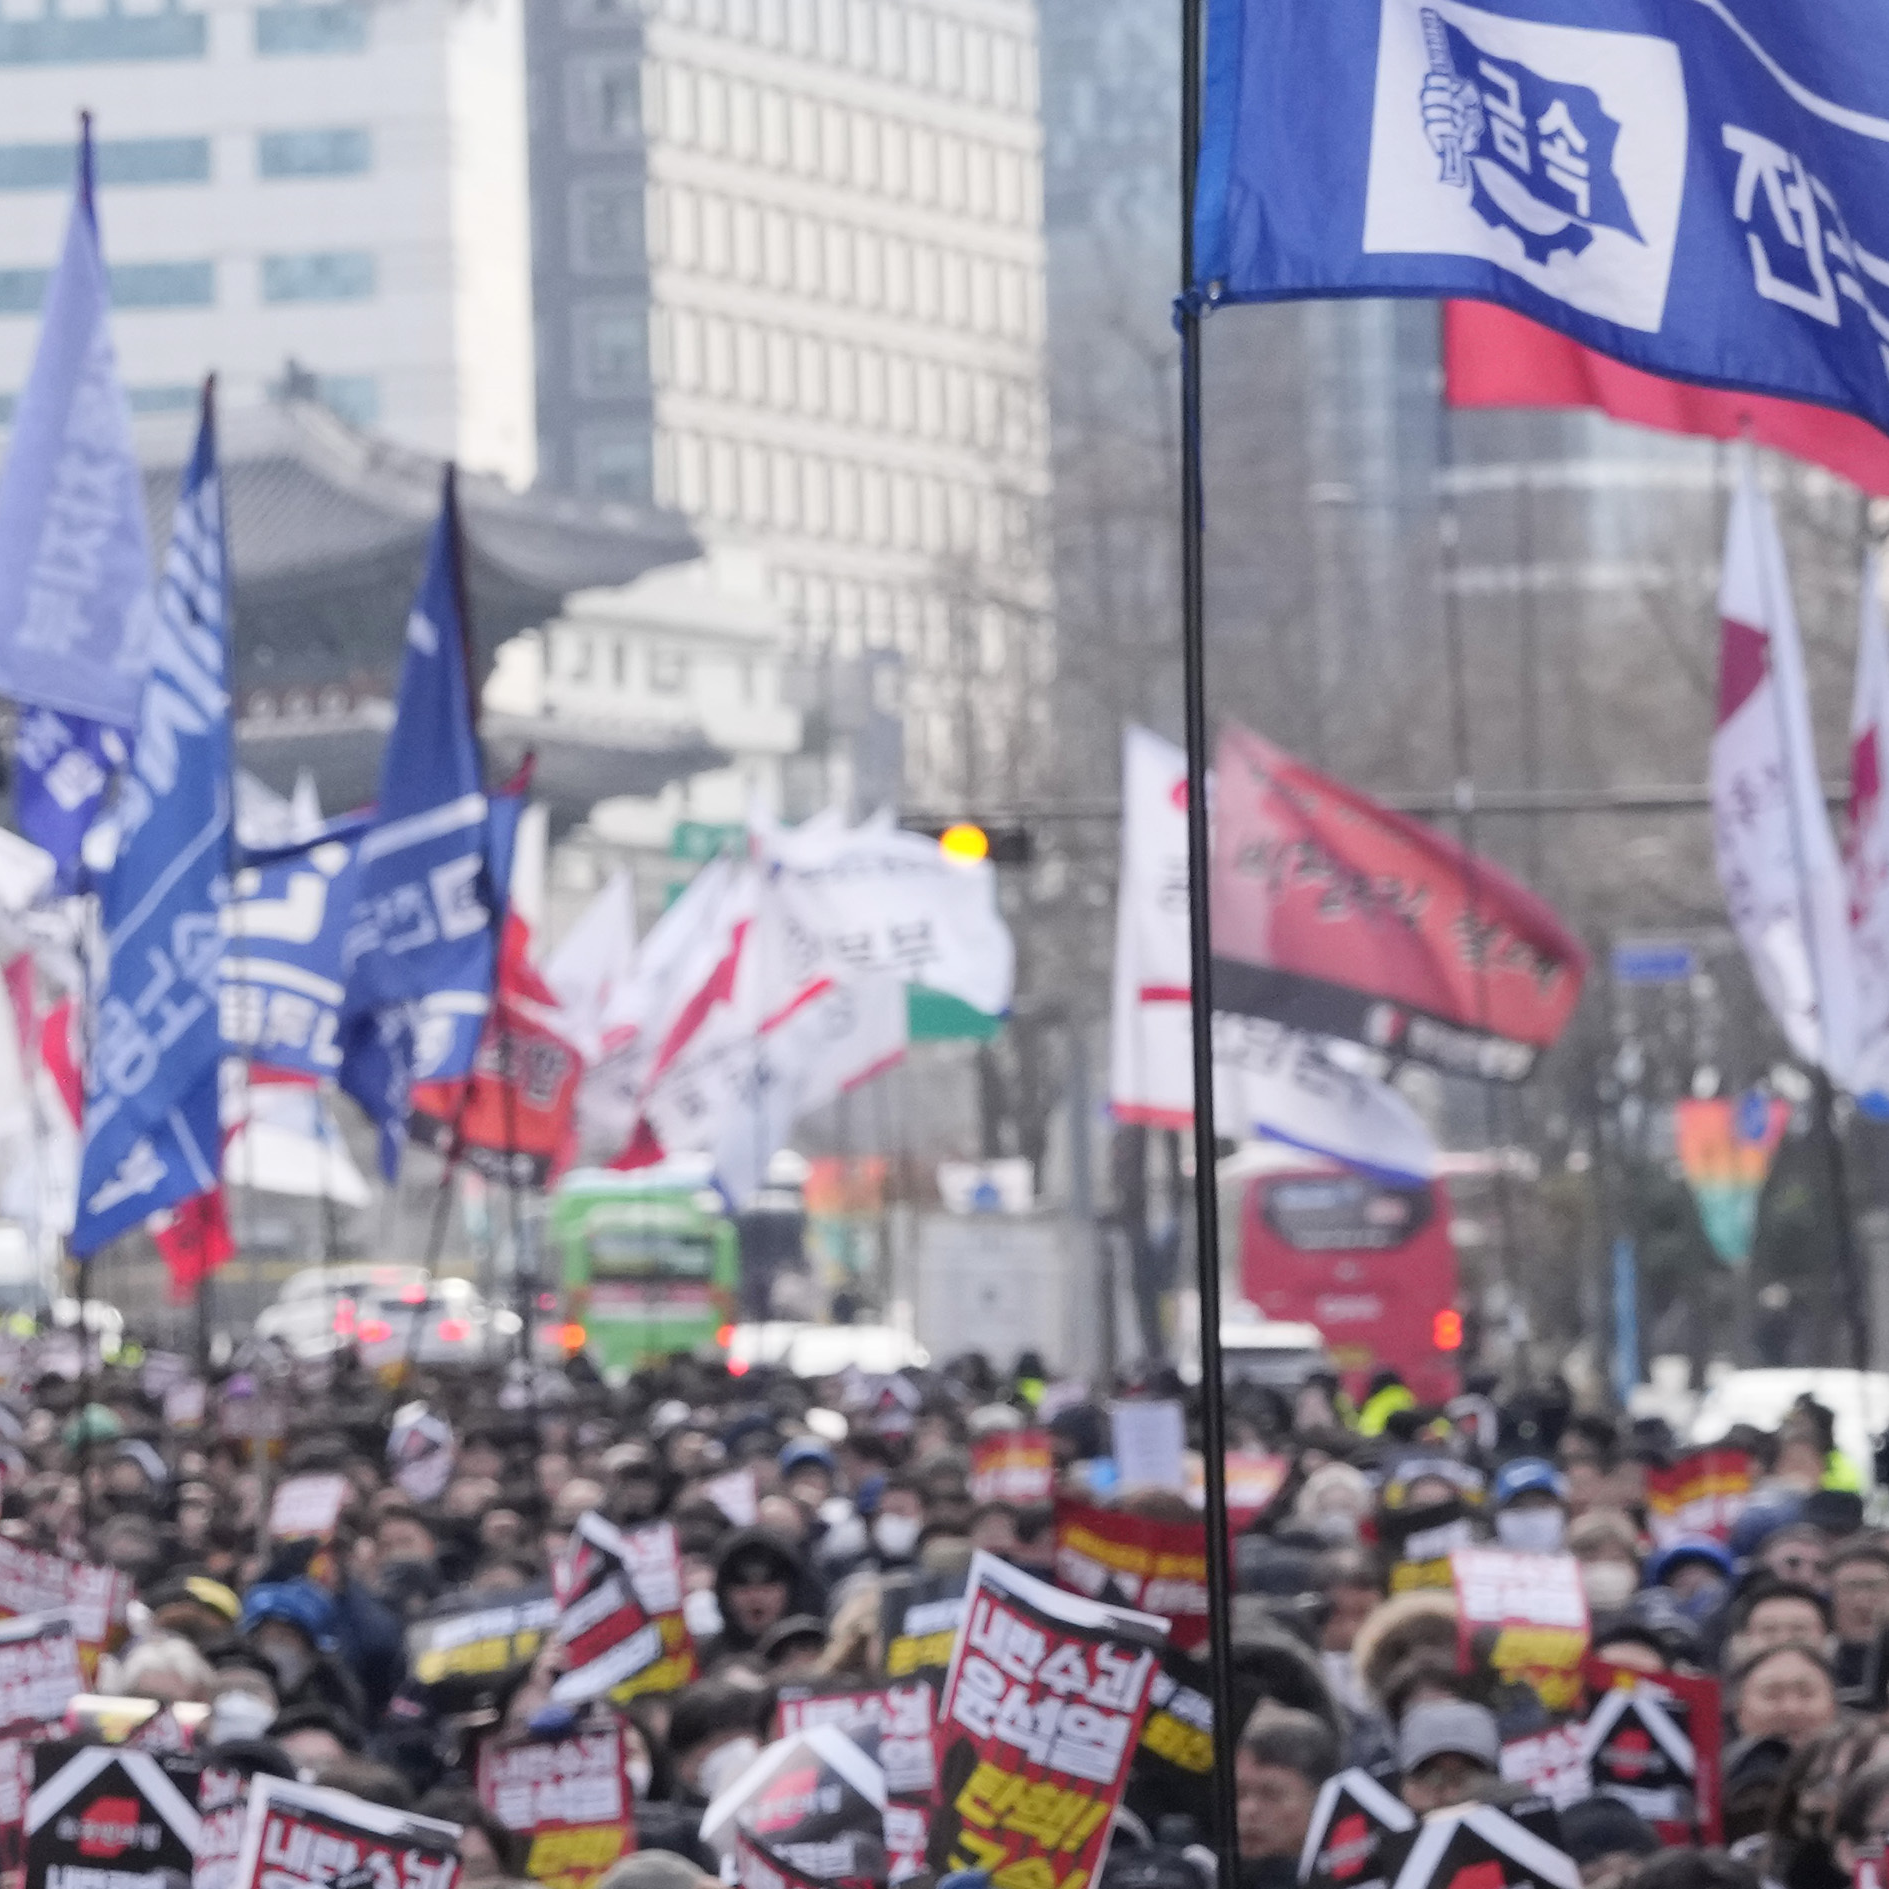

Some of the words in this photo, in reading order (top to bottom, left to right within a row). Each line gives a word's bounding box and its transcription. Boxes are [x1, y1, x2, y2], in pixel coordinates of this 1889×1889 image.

[1479, 57, 1591, 218] 금속
[969, 1598, 1154, 1714] 내란수괴
[952, 1658, 1132, 1784] 윤석열
